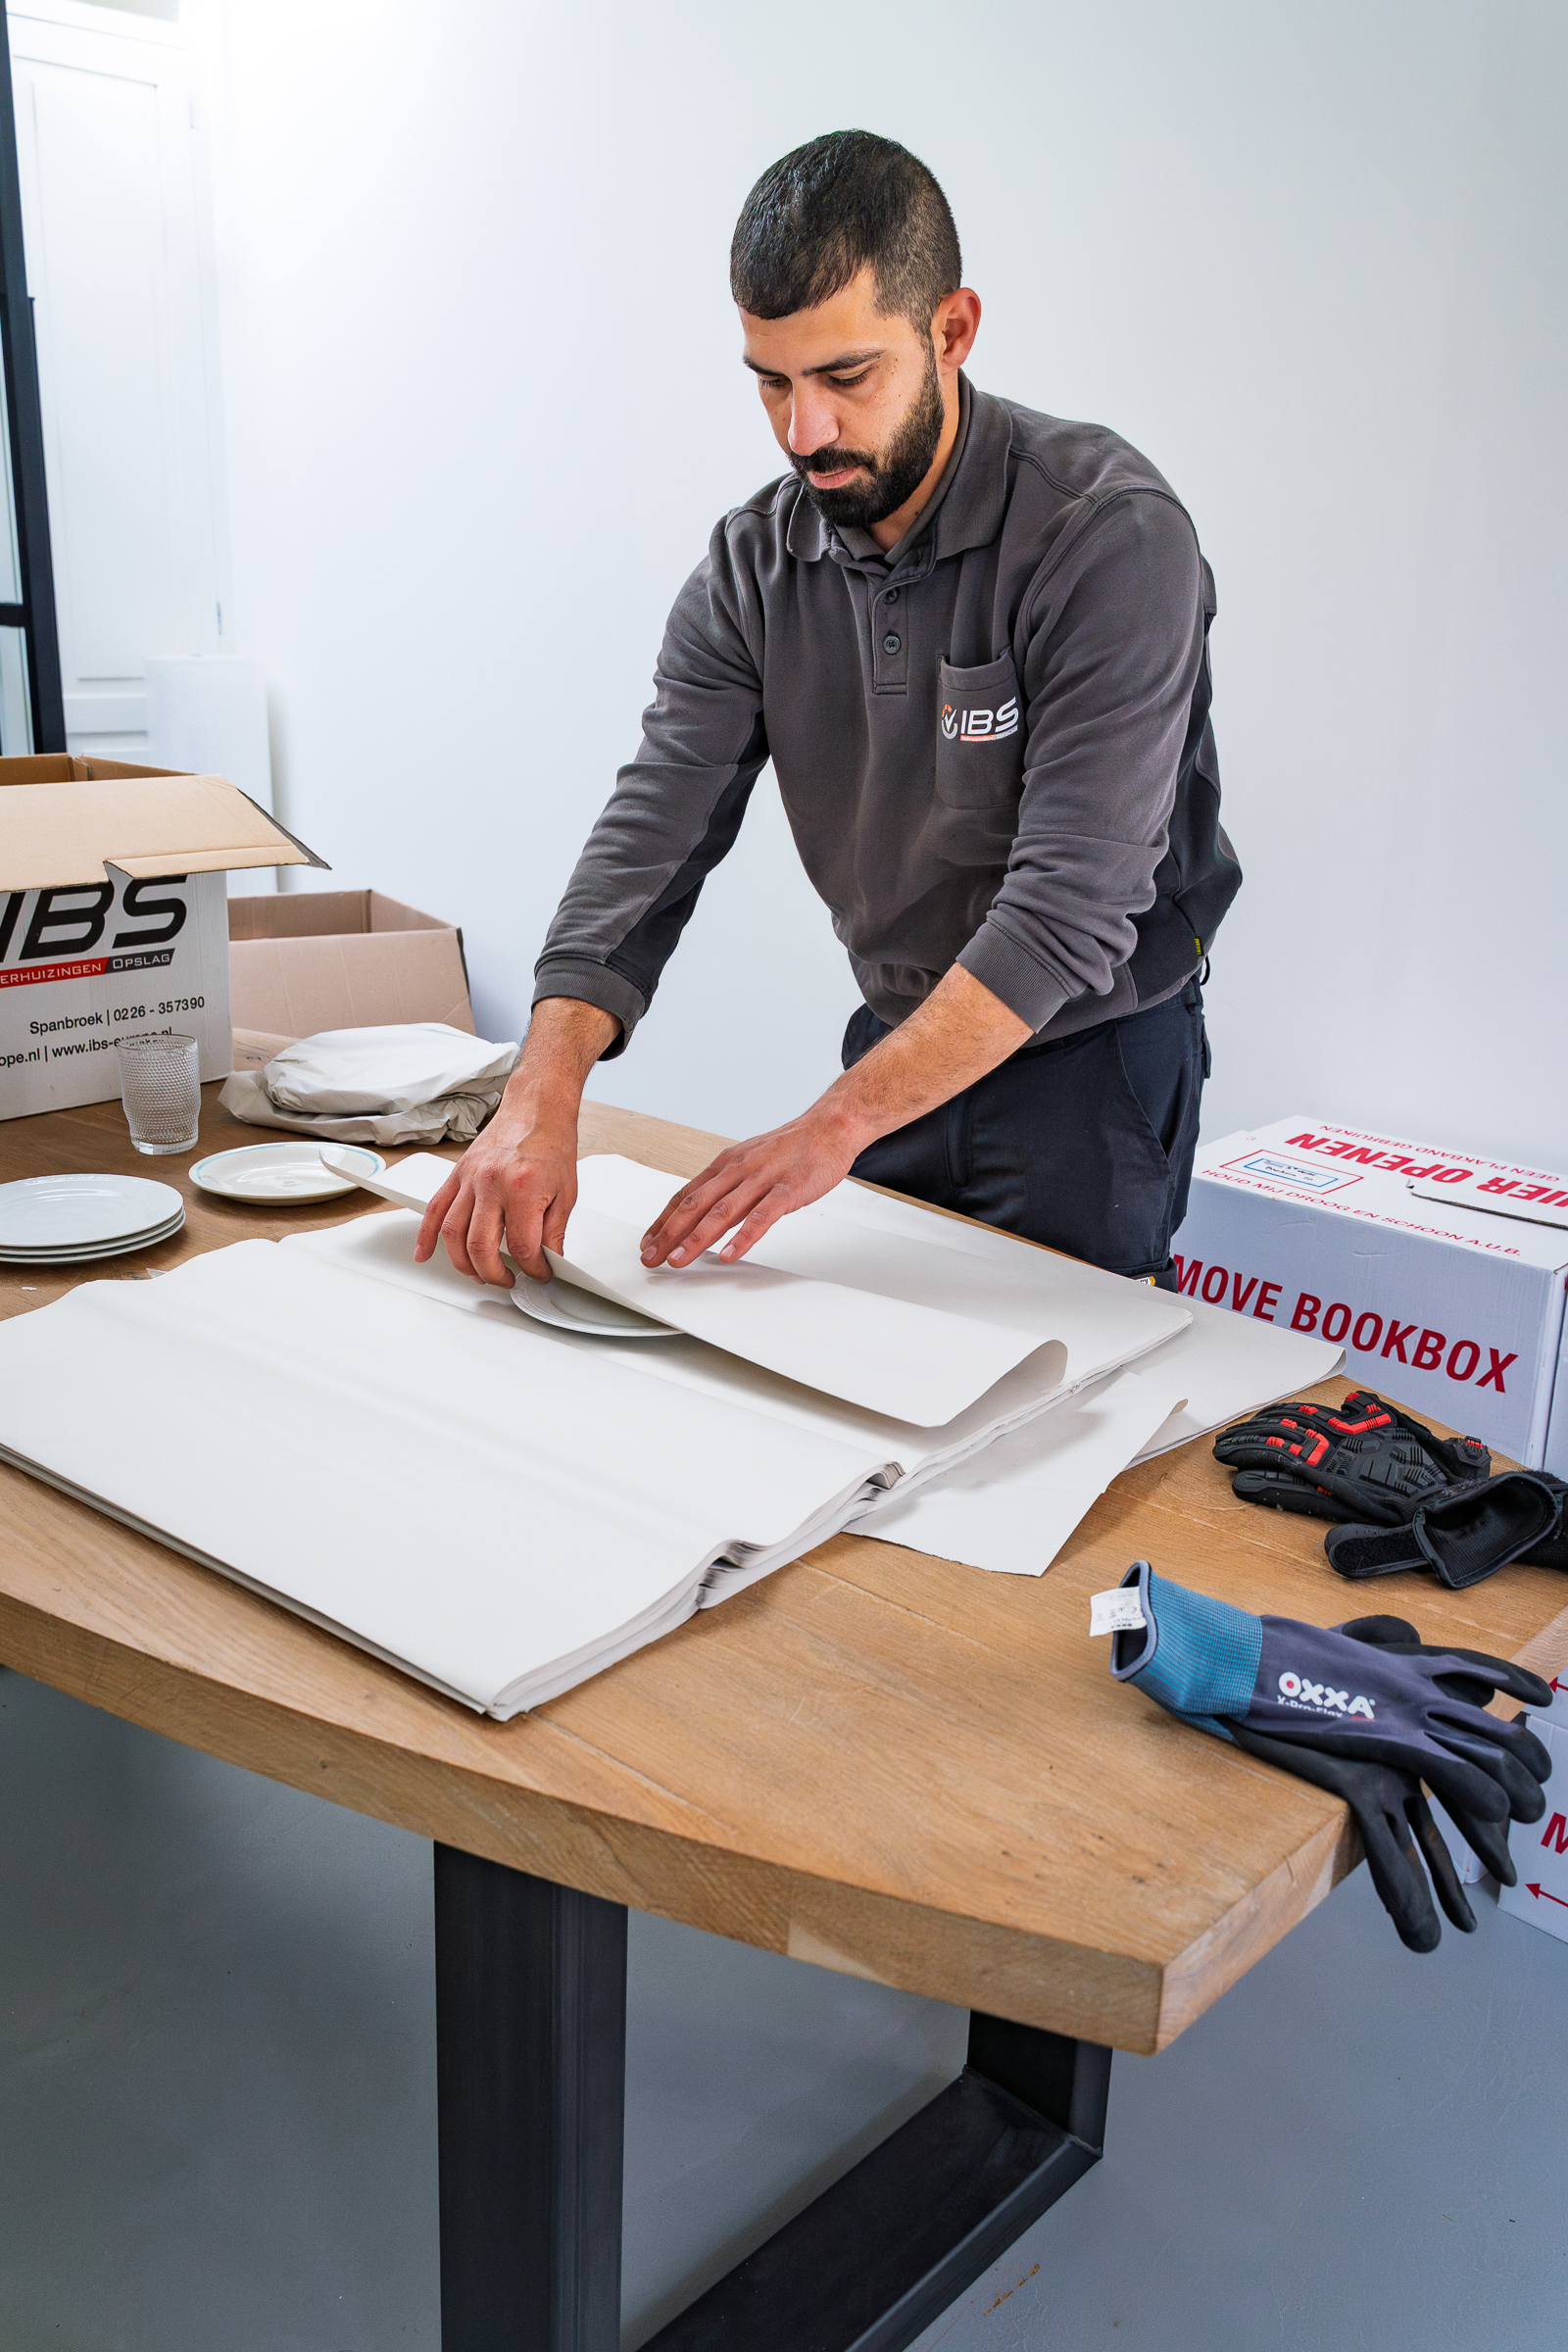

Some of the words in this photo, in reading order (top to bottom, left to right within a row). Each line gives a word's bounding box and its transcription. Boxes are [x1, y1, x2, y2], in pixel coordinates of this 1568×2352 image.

[960, 696, 1019, 735] IBS
[0, 875, 188, 963] IBS
[29, 1012, 104, 1036] Spanbroek
[113, 1004, 147, 1021] 0226
[158, 996, 205, 1015] 357390
[52, 1026, 172, 1058] www.ibs-enl
[1284, 1133, 1474, 1184] OPENEN
[1415, 1148, 1508, 1171] PLAKBAND
[1201, 1169, 1251, 1185] HOUD
[1252, 1183, 1285, 1194] MIJ
[1286, 1192, 1350, 1211] DROOG
[1352, 1209, 1380, 1218] EN
[1381, 1216, 1464, 1241] SCHOON
[1465, 1240, 1521, 1255] A.U.B.
[1173, 1253, 1284, 1322] MOVE
[1290, 1292, 1519, 1394] BOOKBOX
[1278, 1671, 1376, 1720] OXXA
